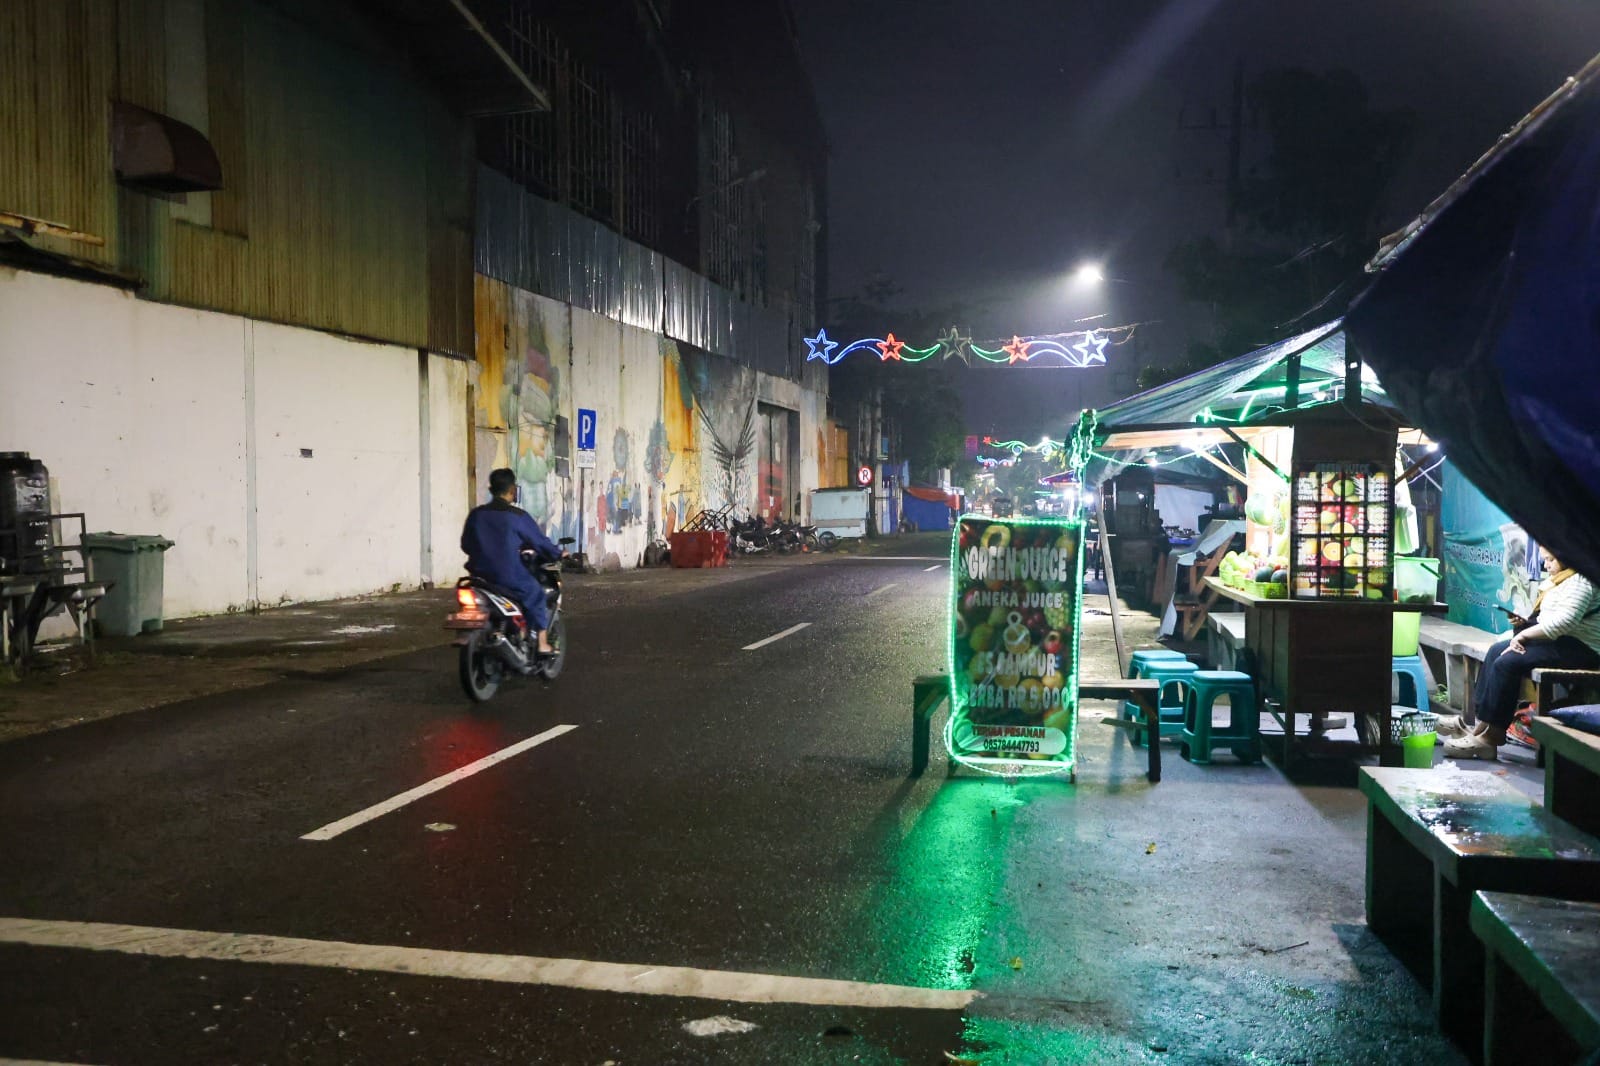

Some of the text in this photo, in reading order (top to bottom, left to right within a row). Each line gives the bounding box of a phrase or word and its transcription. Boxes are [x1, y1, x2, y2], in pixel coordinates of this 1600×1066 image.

[582, 415, 591, 443] P
[968, 545, 1067, 582] GREEN JUICE
[972, 590, 1063, 608] ANEKA JUICE
[1003, 611, 1031, 645] &
[976, 651, 994, 674] ES
